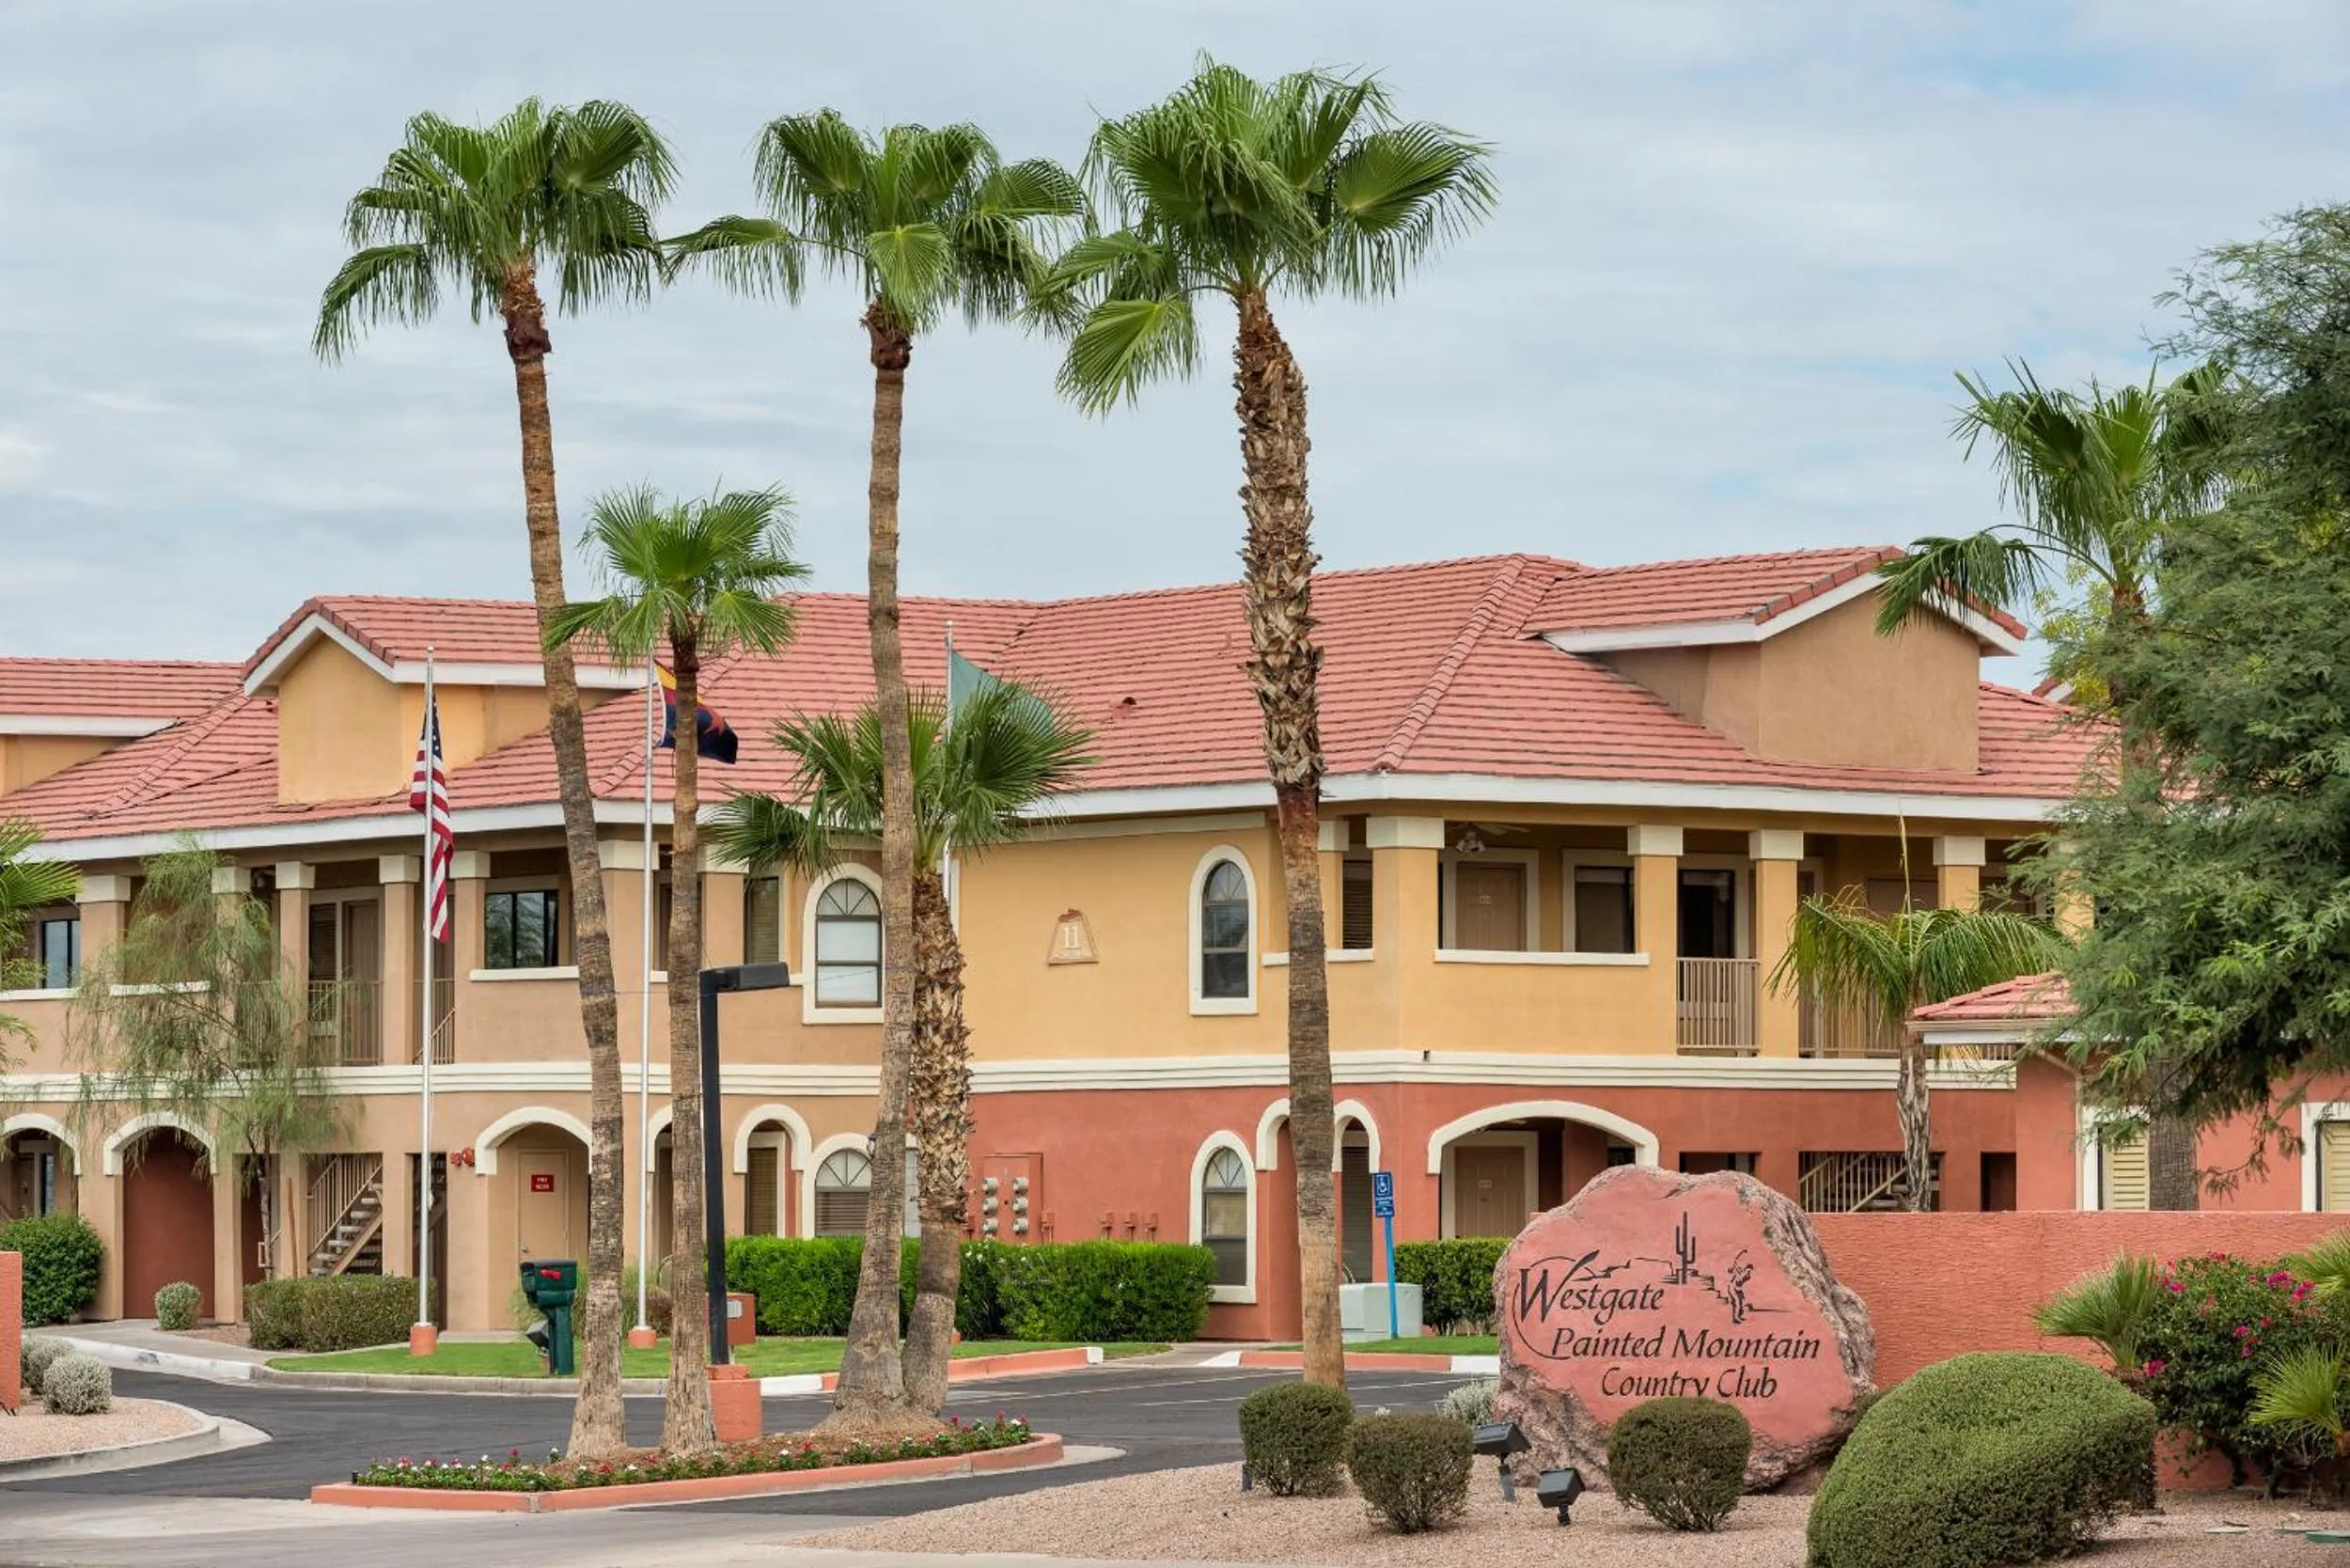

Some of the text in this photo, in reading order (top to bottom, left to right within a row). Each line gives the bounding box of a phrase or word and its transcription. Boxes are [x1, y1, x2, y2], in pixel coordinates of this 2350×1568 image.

[1519, 1249, 1665, 1325] Westgate
[1552, 1325, 1820, 1359] Painted Mountain
[1716, 1365, 1778, 1398] Club
